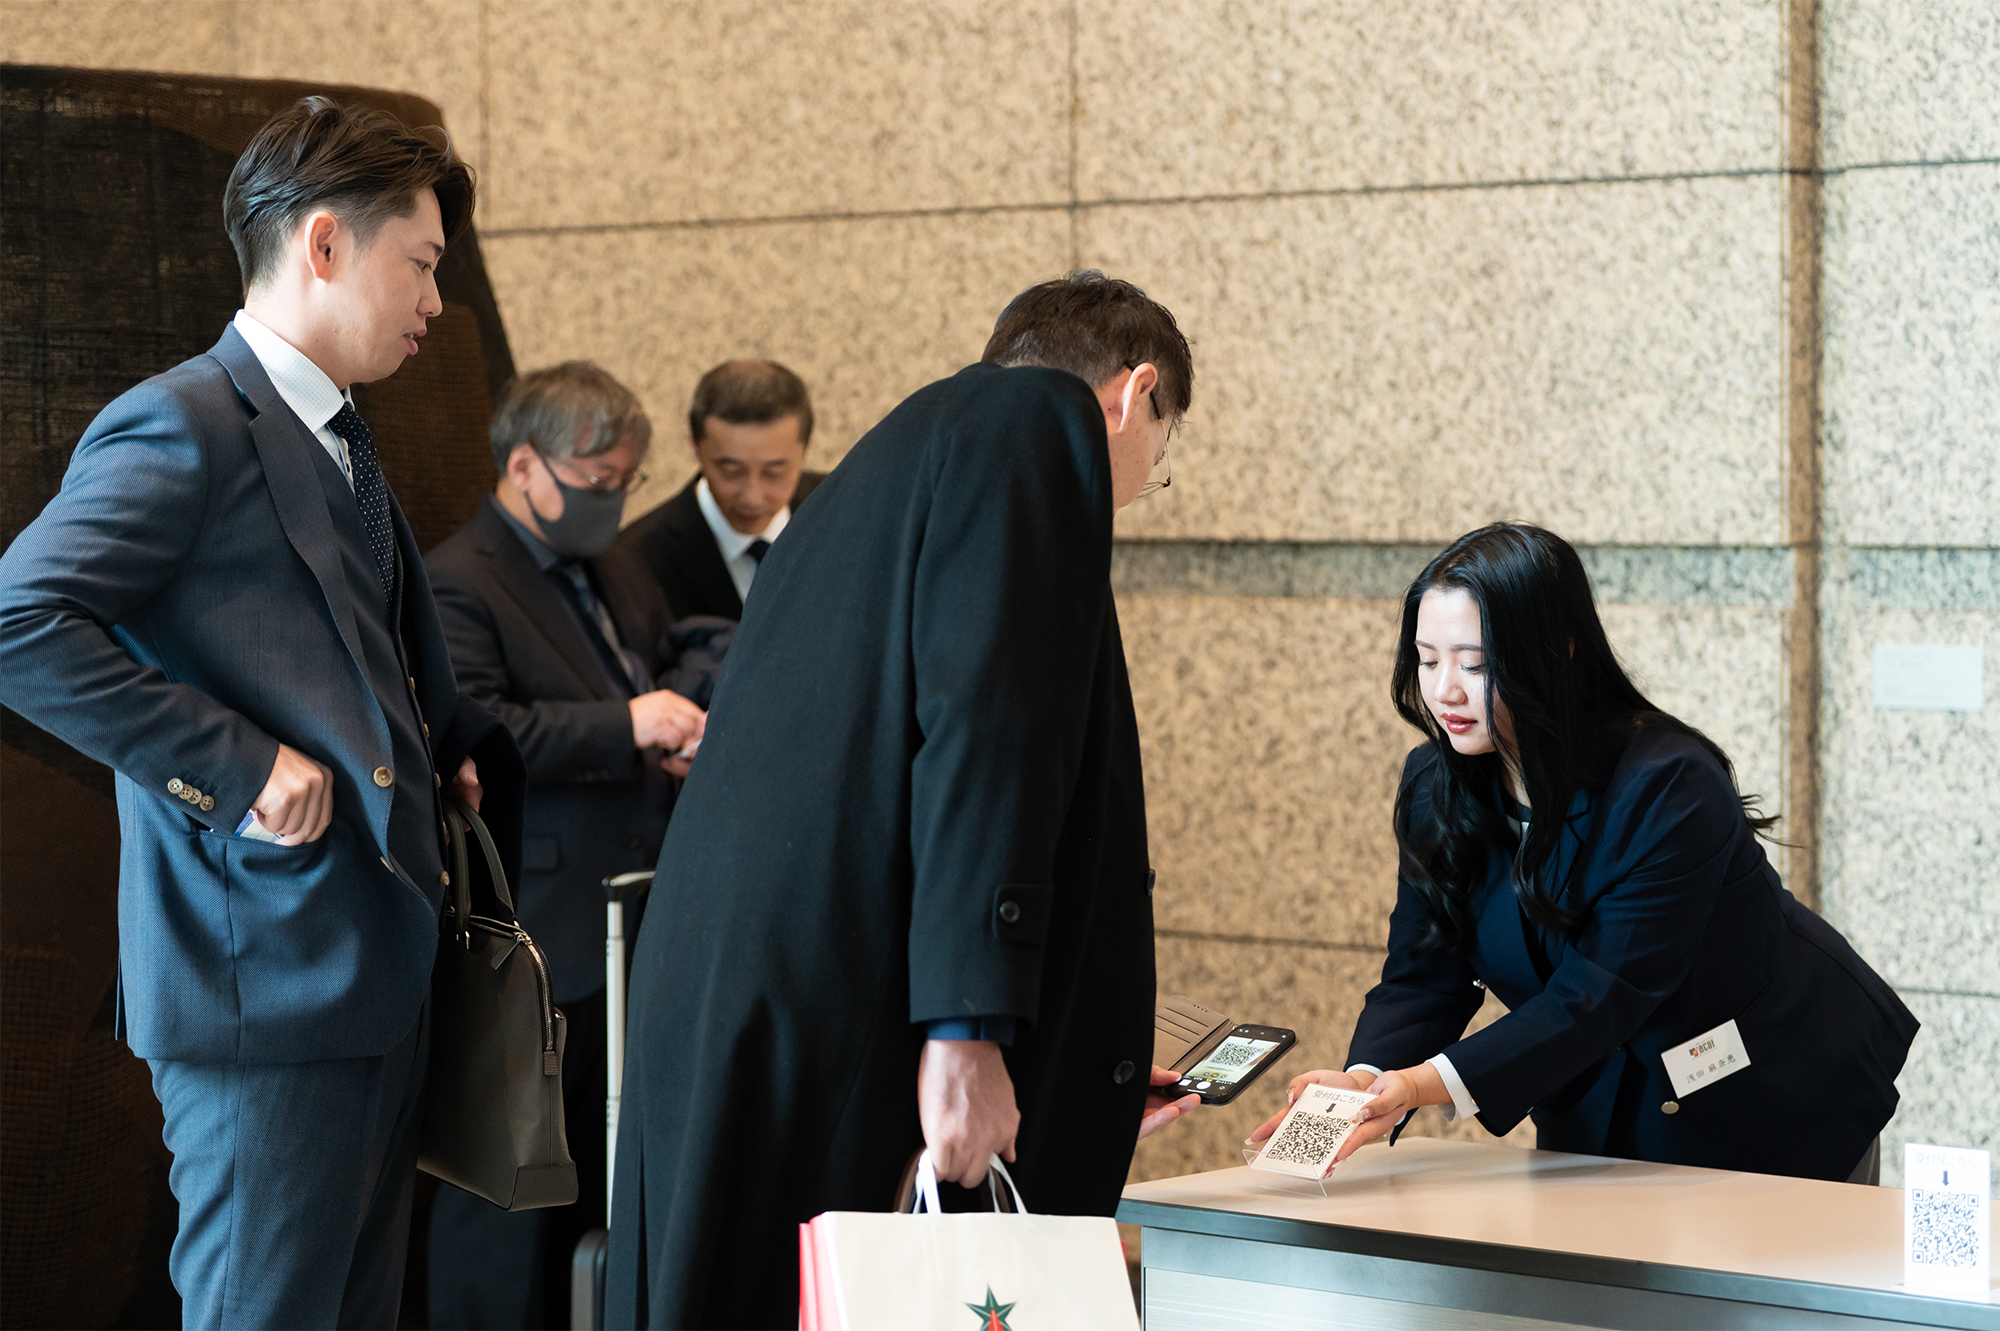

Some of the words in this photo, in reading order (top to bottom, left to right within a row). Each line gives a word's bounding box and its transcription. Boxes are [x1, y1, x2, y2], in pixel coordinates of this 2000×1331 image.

[1312, 1090, 1365, 1105] 受付はこちら
[1915, 1151, 1977, 1169] 受付はこちら
